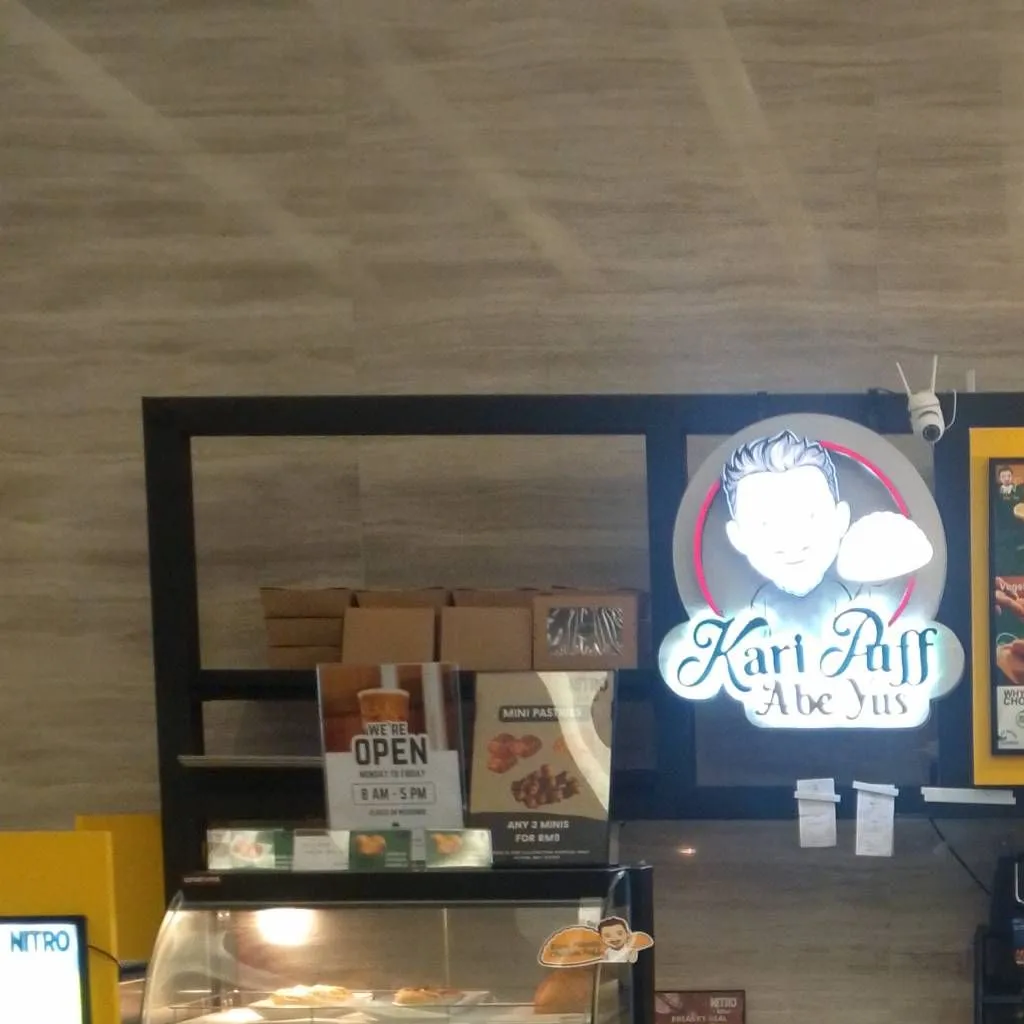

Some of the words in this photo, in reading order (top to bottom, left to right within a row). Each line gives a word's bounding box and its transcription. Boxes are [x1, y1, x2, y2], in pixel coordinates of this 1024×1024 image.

[676, 615, 806, 692] Kari
[819, 607, 938, 688] Puff
[755, 680, 833, 716] Abe
[846, 677, 908, 720] Yus
[1004, 689, 1024, 698] WHY
[502, 708, 529, 718] MINI
[355, 738, 428, 766] OPEN
[361, 788, 369, 800] 8
[372, 788, 389, 800] AM
[400, 787, 407, 800] 5
[410, 787, 427, 799] PM
[507, 821, 528, 829] ANY
[540, 820, 569, 829] MINIS
[515, 834, 535, 842] FOR
[10, 930, 70, 952] NITRO
